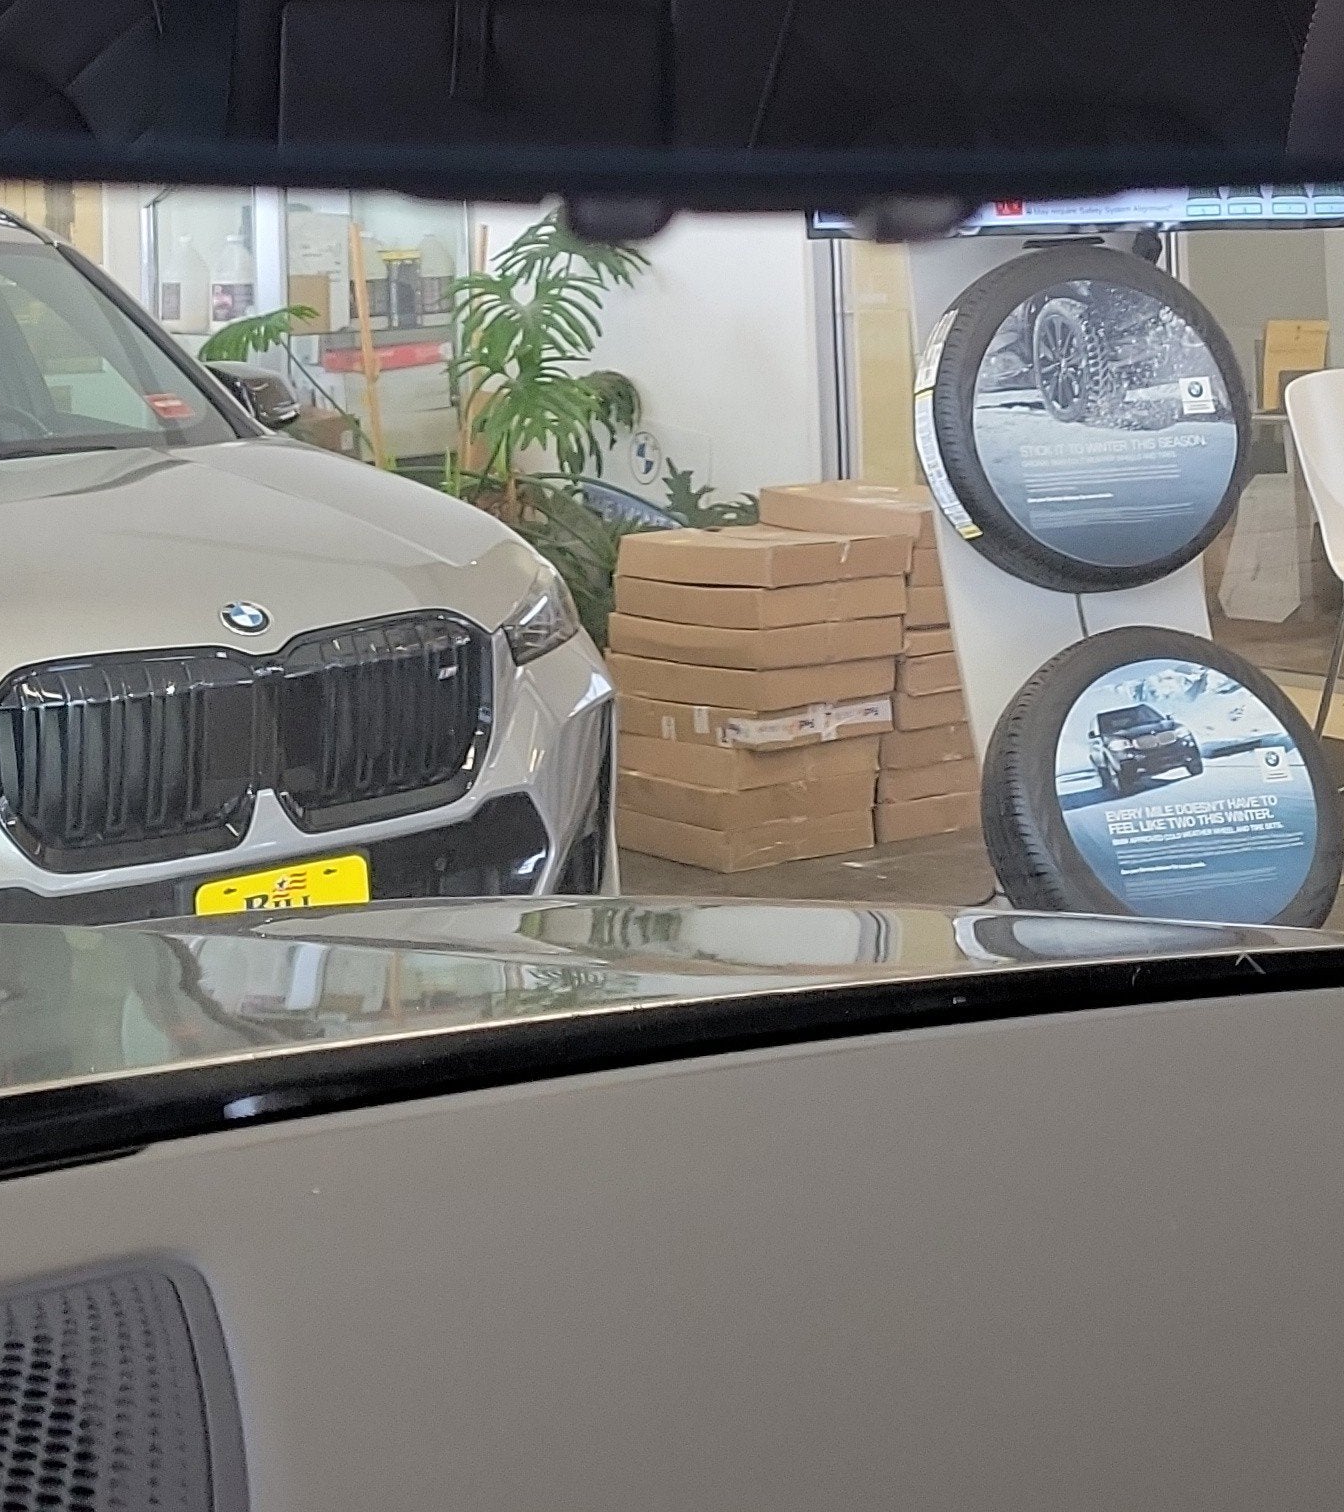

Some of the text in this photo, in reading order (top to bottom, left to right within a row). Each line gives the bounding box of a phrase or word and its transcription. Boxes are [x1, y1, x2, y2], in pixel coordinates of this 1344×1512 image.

[1069, 443, 1083, 454] TO
[1085, 440, 1128, 453] WINTER
[1131, 438, 1156, 450] THIS
[1105, 795, 1278, 822] EVERY MILE DOESN'T HAVE TO
[1108, 808, 1275, 835] FEEL LIKE TWO THIS WINTER.
